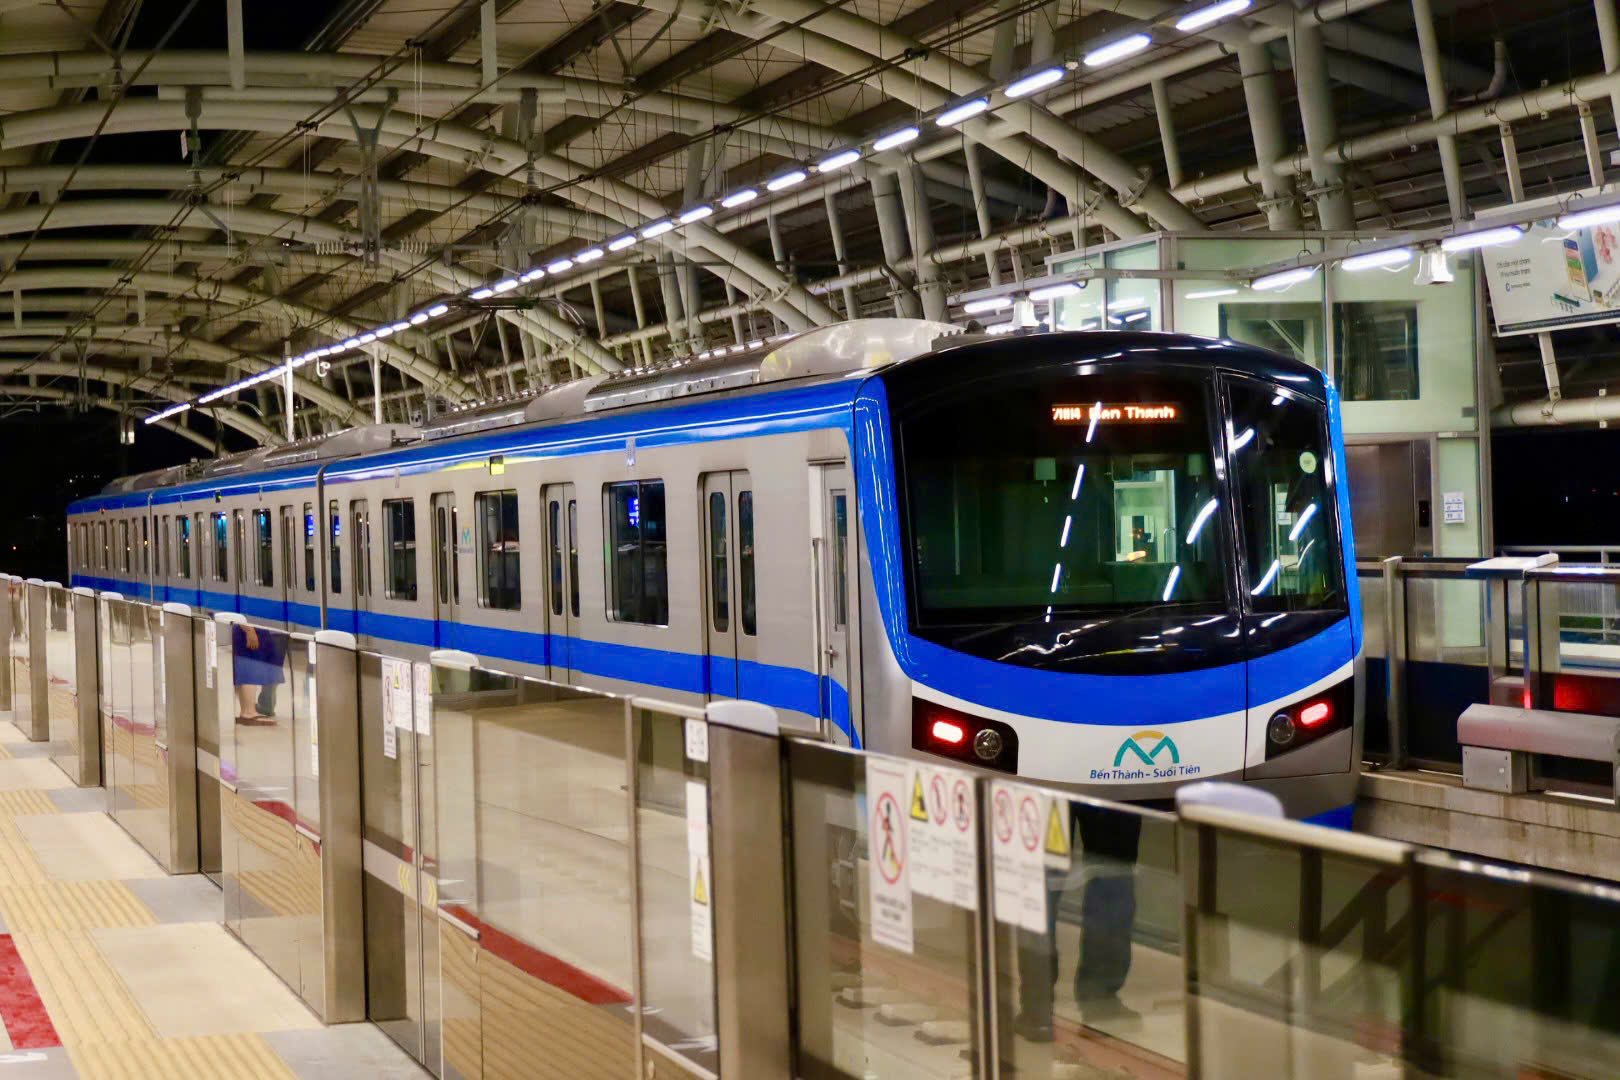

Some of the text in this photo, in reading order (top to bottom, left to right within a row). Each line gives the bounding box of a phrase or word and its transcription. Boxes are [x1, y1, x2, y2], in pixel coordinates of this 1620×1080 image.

[1124, 406, 1175, 419] Thanh
[1090, 769, 1110, 780] Bến
[1112, 768, 1143, 780] Thành
[1153, 766, 1176, 778] Suối
[1178, 764, 1200, 775] Tiên
